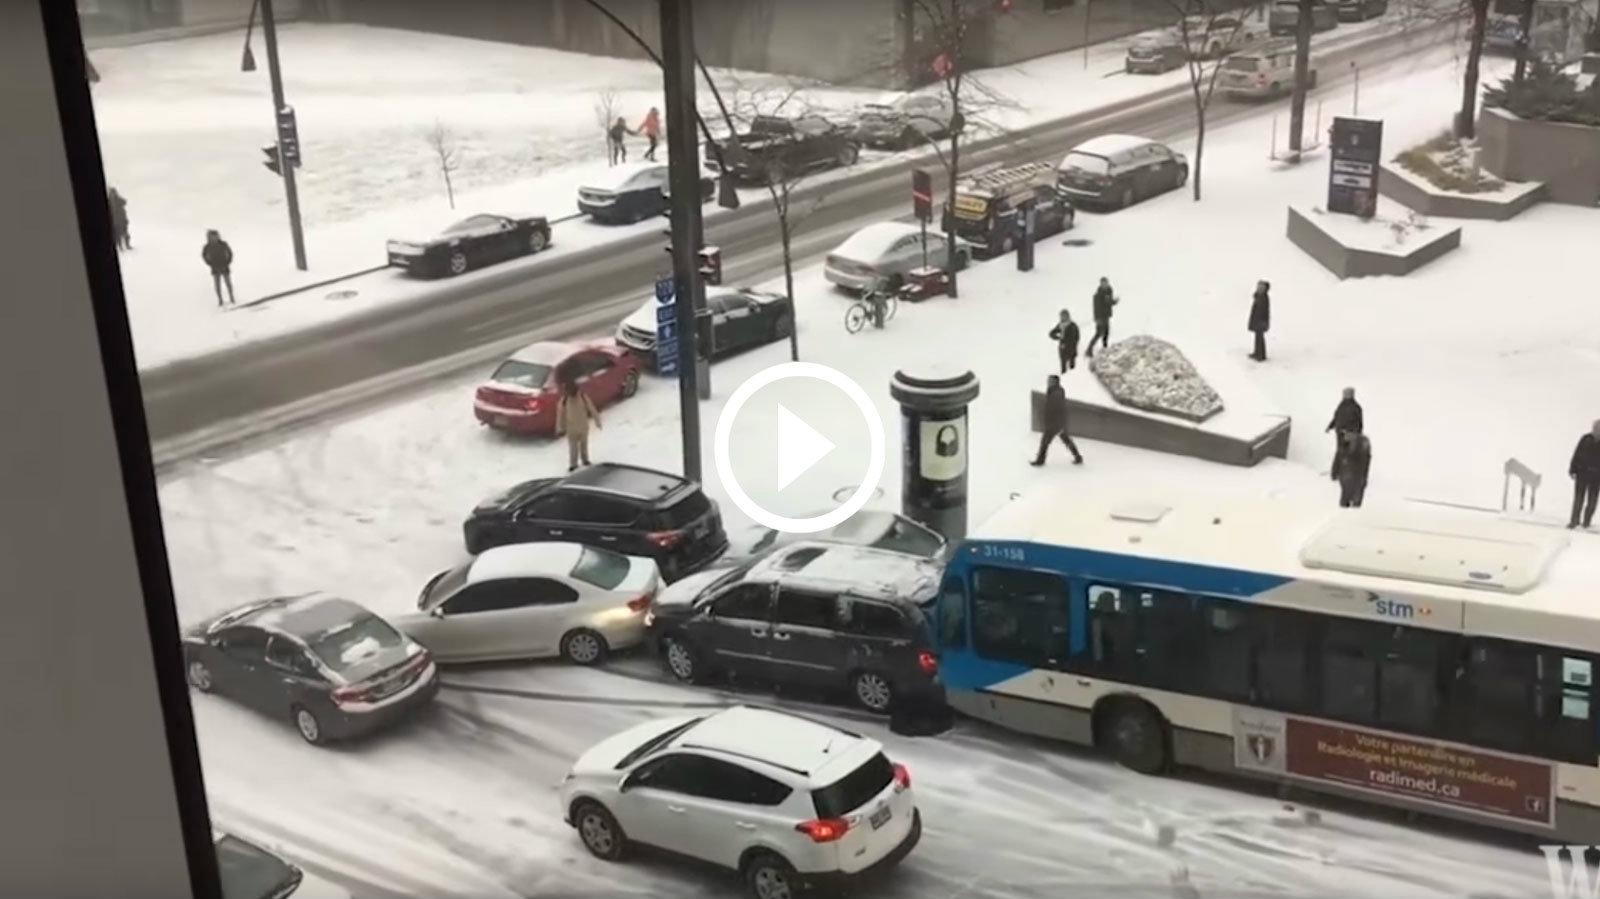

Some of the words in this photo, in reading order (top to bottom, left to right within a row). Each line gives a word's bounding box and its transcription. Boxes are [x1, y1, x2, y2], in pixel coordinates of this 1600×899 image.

[1376, 599, 1415, 618] stm
[1317, 740, 1382, 763] Radiologie
[1383, 754, 1397, 768] et
[1355, 733, 1390, 751] Votre
[1458, 756, 1476, 768] en
[1369, 769, 1460, 797] radimed.ca
